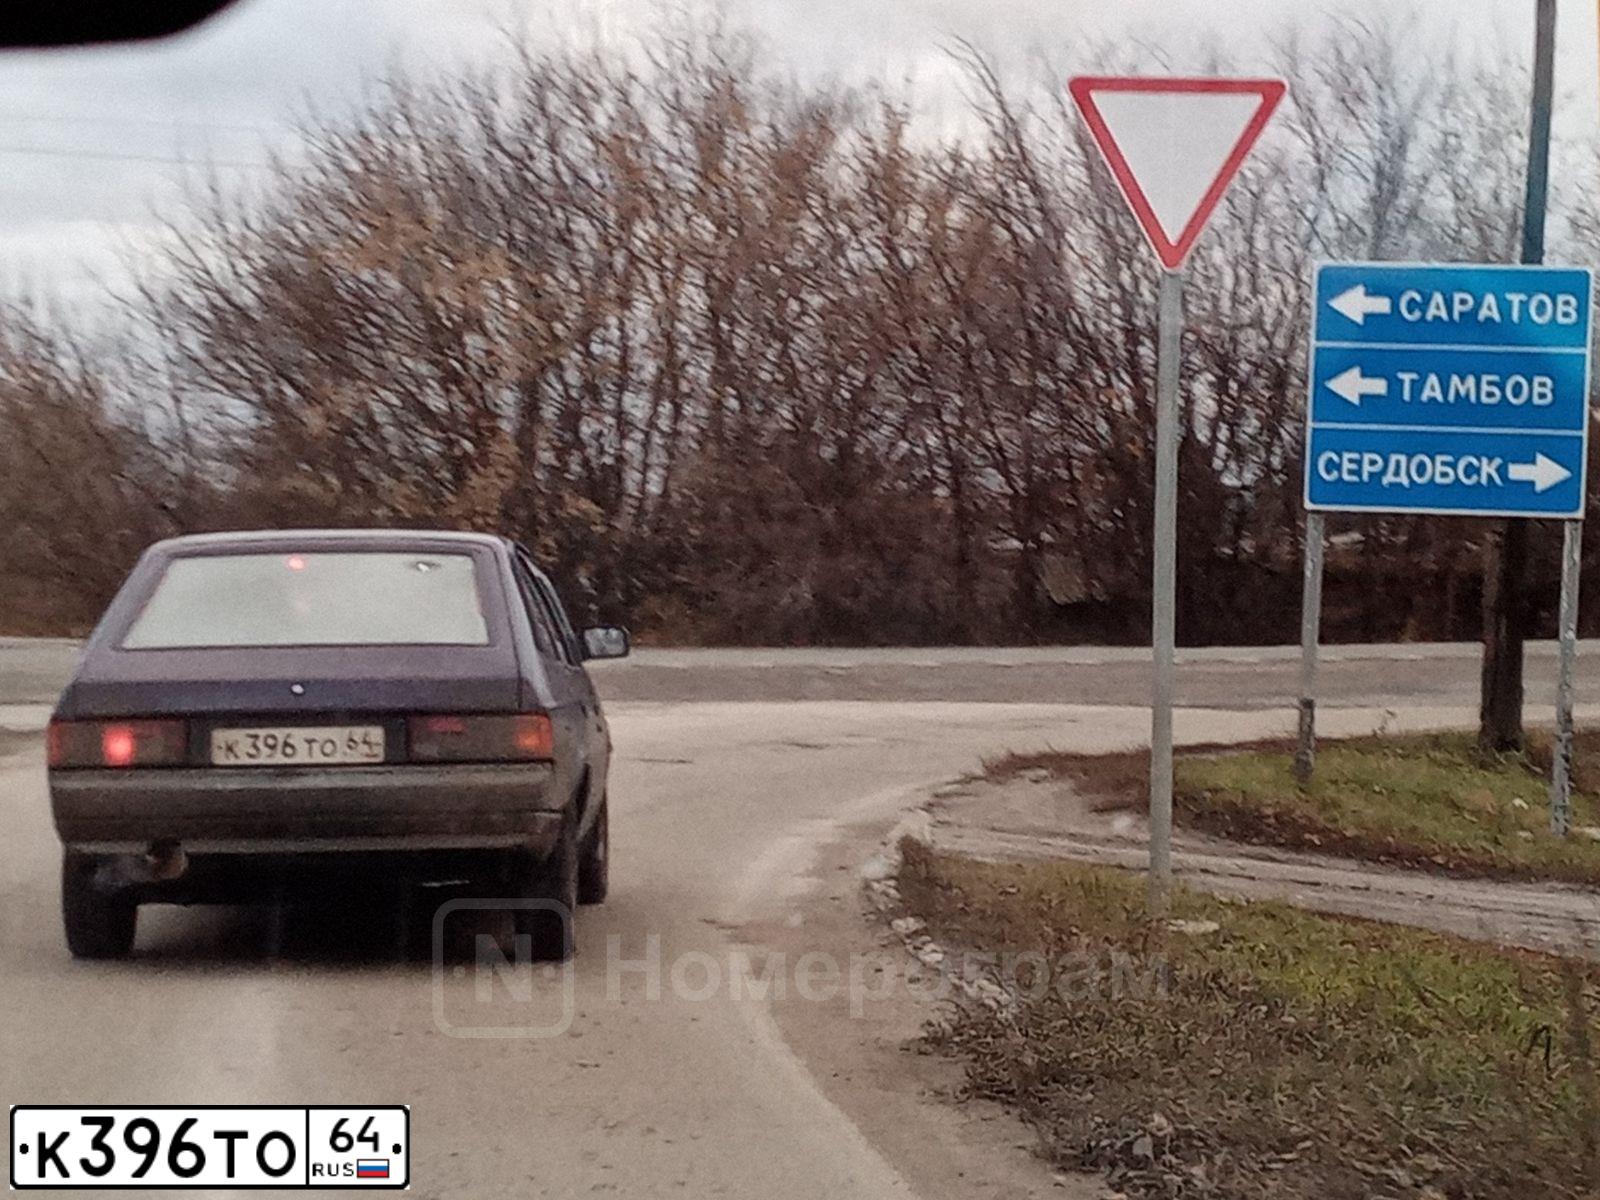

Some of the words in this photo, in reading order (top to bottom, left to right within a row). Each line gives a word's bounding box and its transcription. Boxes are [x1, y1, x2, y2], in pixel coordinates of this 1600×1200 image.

[1399, 289, 1578, 325] САРАТОВ
[1397, 372, 1554, 406] ТАМБОВ
[1317, 451, 1504, 488] СЕРДОБСК
